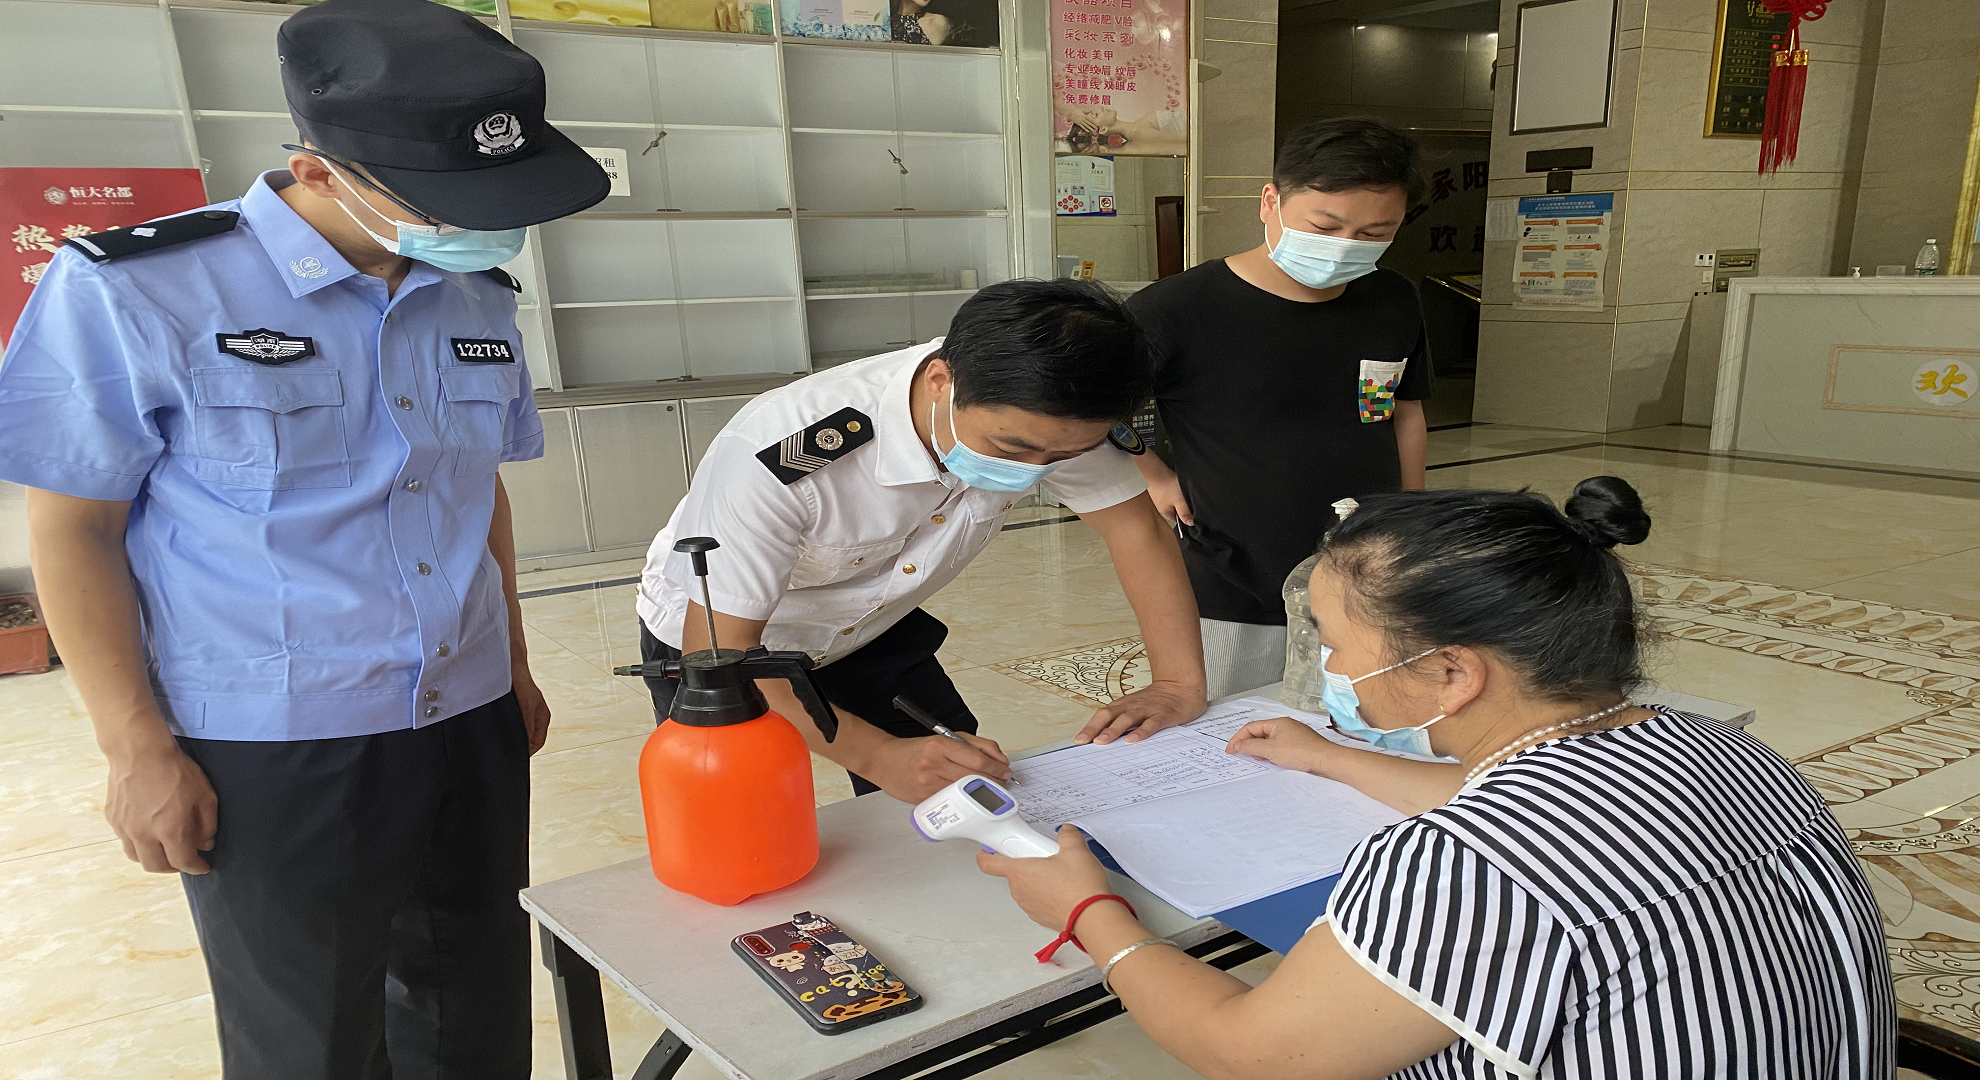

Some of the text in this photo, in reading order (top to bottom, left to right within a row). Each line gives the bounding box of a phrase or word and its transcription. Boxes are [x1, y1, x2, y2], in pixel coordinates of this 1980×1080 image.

[1063, 12, 1133, 27] 经络减肥 V脸
[1065, 28, 1134, 45] 彩妆系列
[1064, 48, 1114, 61] 化妆 美甲
[1115, 66, 1137, 77] 纹唇
[1065, 79, 1137, 92] 美瞳线 双眼皮
[1065, 93, 1111, 106] 免费修眉
[492, 143, 516, 155] POLICE
[69, 186, 133, 198] 恒大名都
[457, 343, 510, 358] 122734
[1914, 364, 1968, 399] 欢
